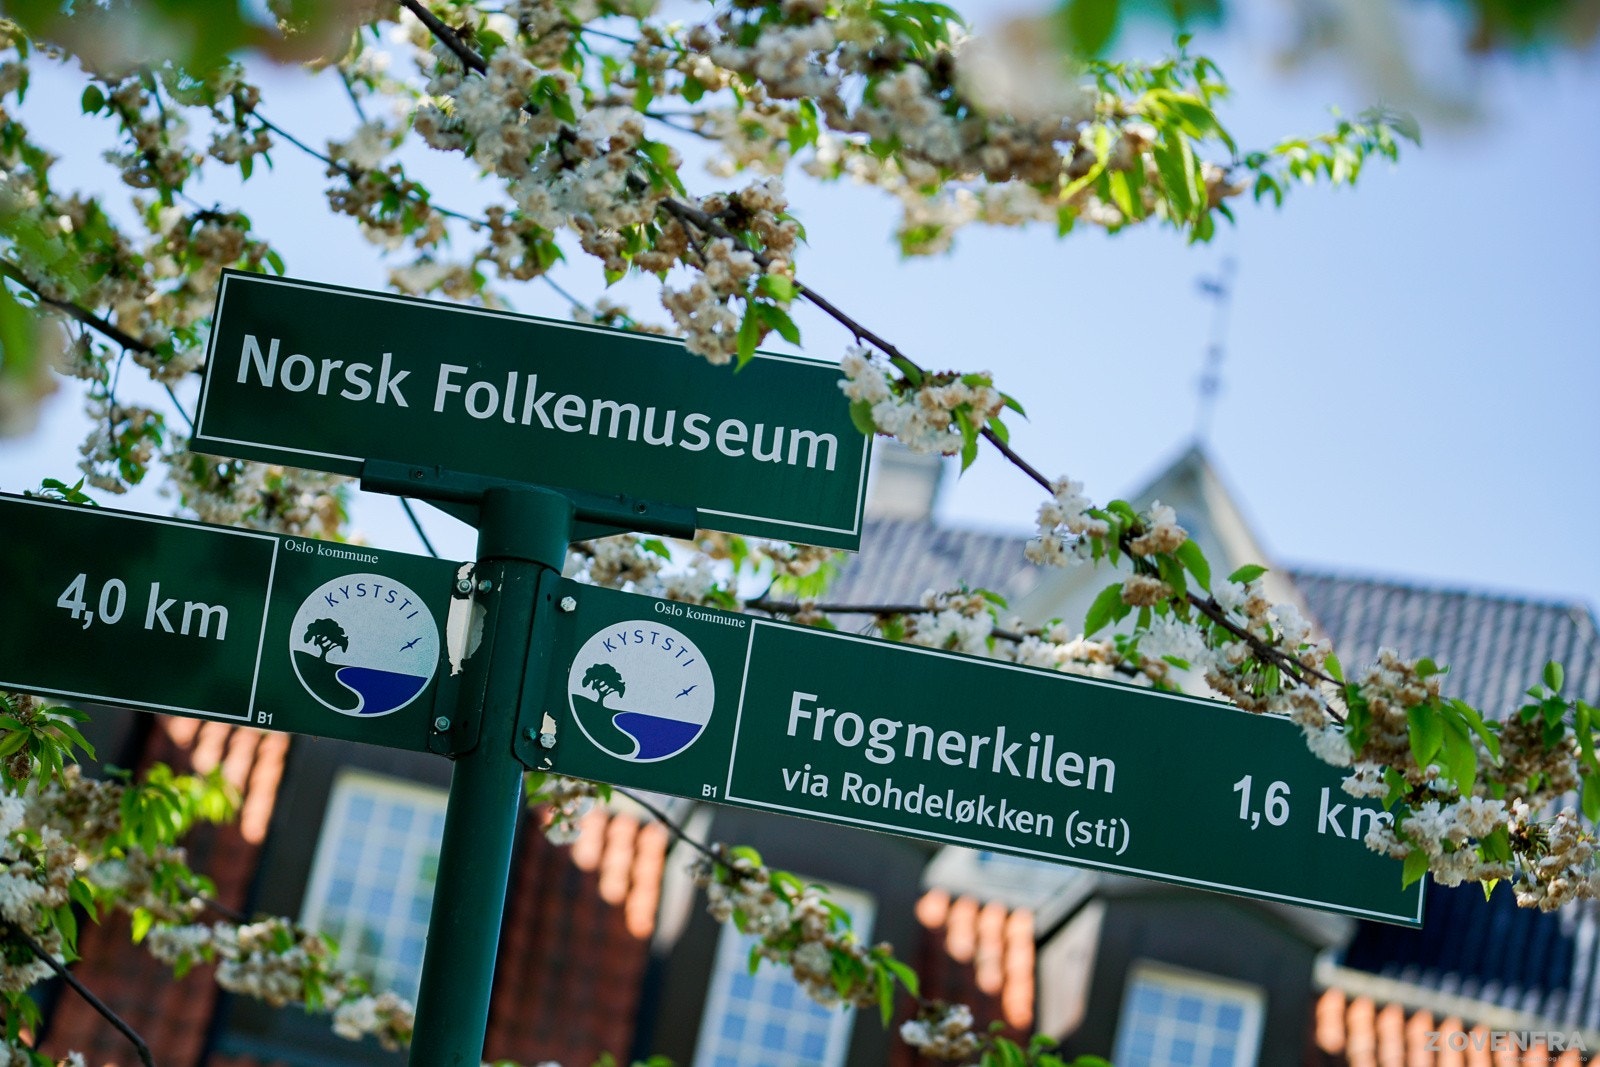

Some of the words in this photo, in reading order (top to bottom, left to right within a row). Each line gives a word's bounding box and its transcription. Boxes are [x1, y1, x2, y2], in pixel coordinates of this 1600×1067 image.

[236, 334, 411, 408] Norsk
[433, 363, 839, 472] Folkemuseum
[284, 539, 314, 554] Oslo
[317, 544, 379, 564] kommune
[56, 573, 127, 630] 4,0
[144, 581, 229, 641] km
[324, 583, 419, 620] KYSTSTI
[654, 601, 683, 617] Oslo
[685, 606, 746, 628] kommune
[602, 629, 695, 668] KYSTSTI
[257, 711, 274, 726] B1
[786, 691, 1116, 793] Frognerkilen
[702, 784, 718, 798] B1
[782, 764, 829, 798] via
[841, 772, 1054, 838] Rohdeløkken
[1065, 810, 1130, 856] (sti)
[1233, 774, 1291, 831] 1,6
